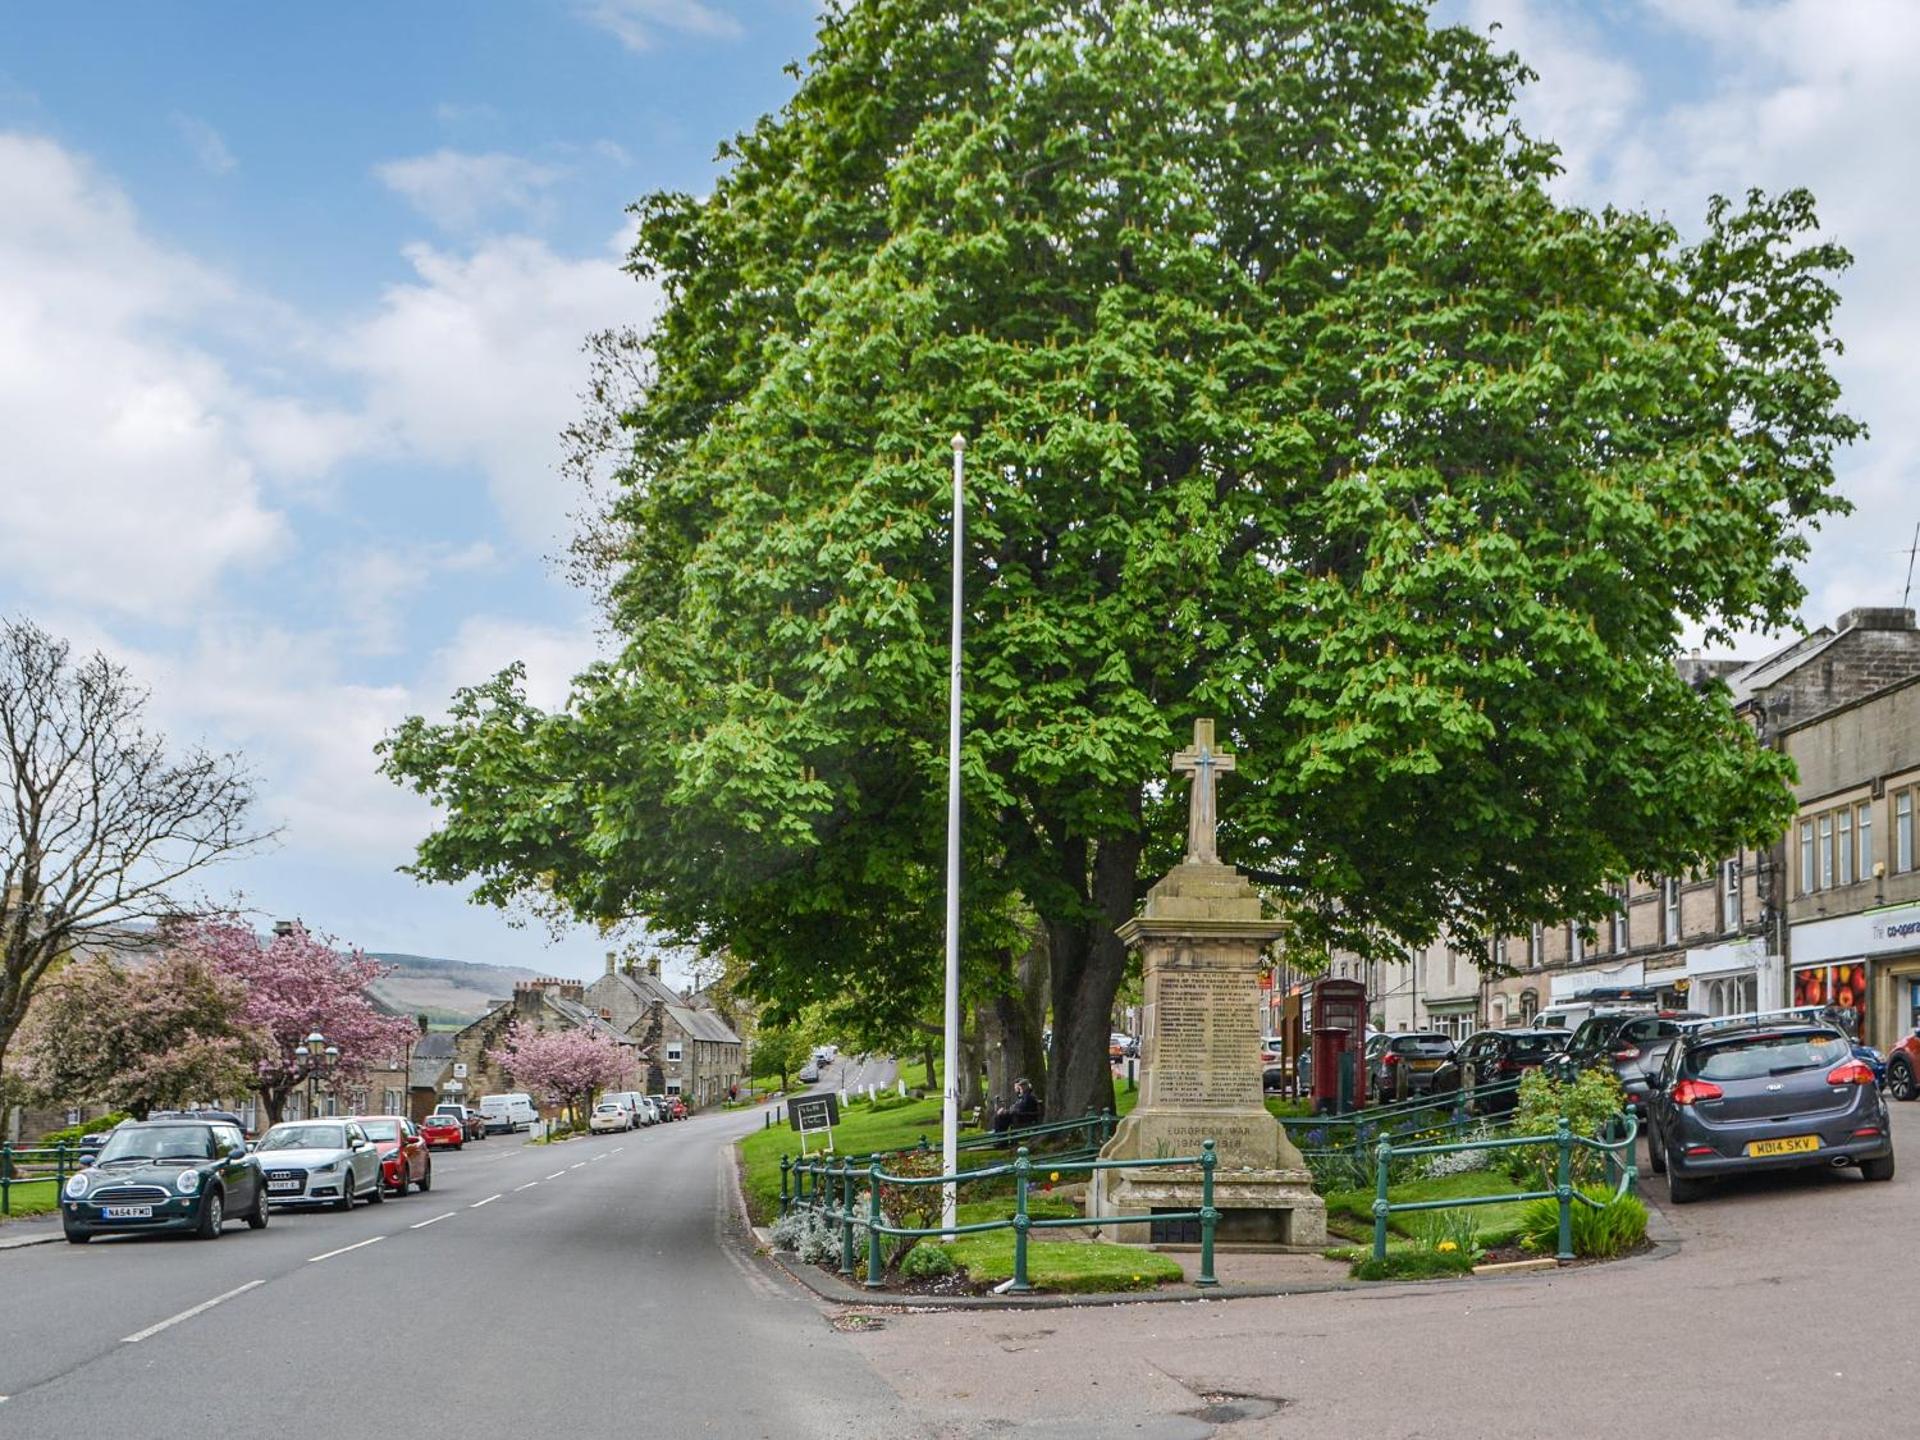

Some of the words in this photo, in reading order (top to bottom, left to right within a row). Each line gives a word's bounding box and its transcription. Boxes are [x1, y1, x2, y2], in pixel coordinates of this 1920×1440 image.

[1168, 1126, 1222, 1135] EUROPEAN
[1229, 1126, 1249, 1136] WAR
[1787, 1138, 1809, 1151] SKV
